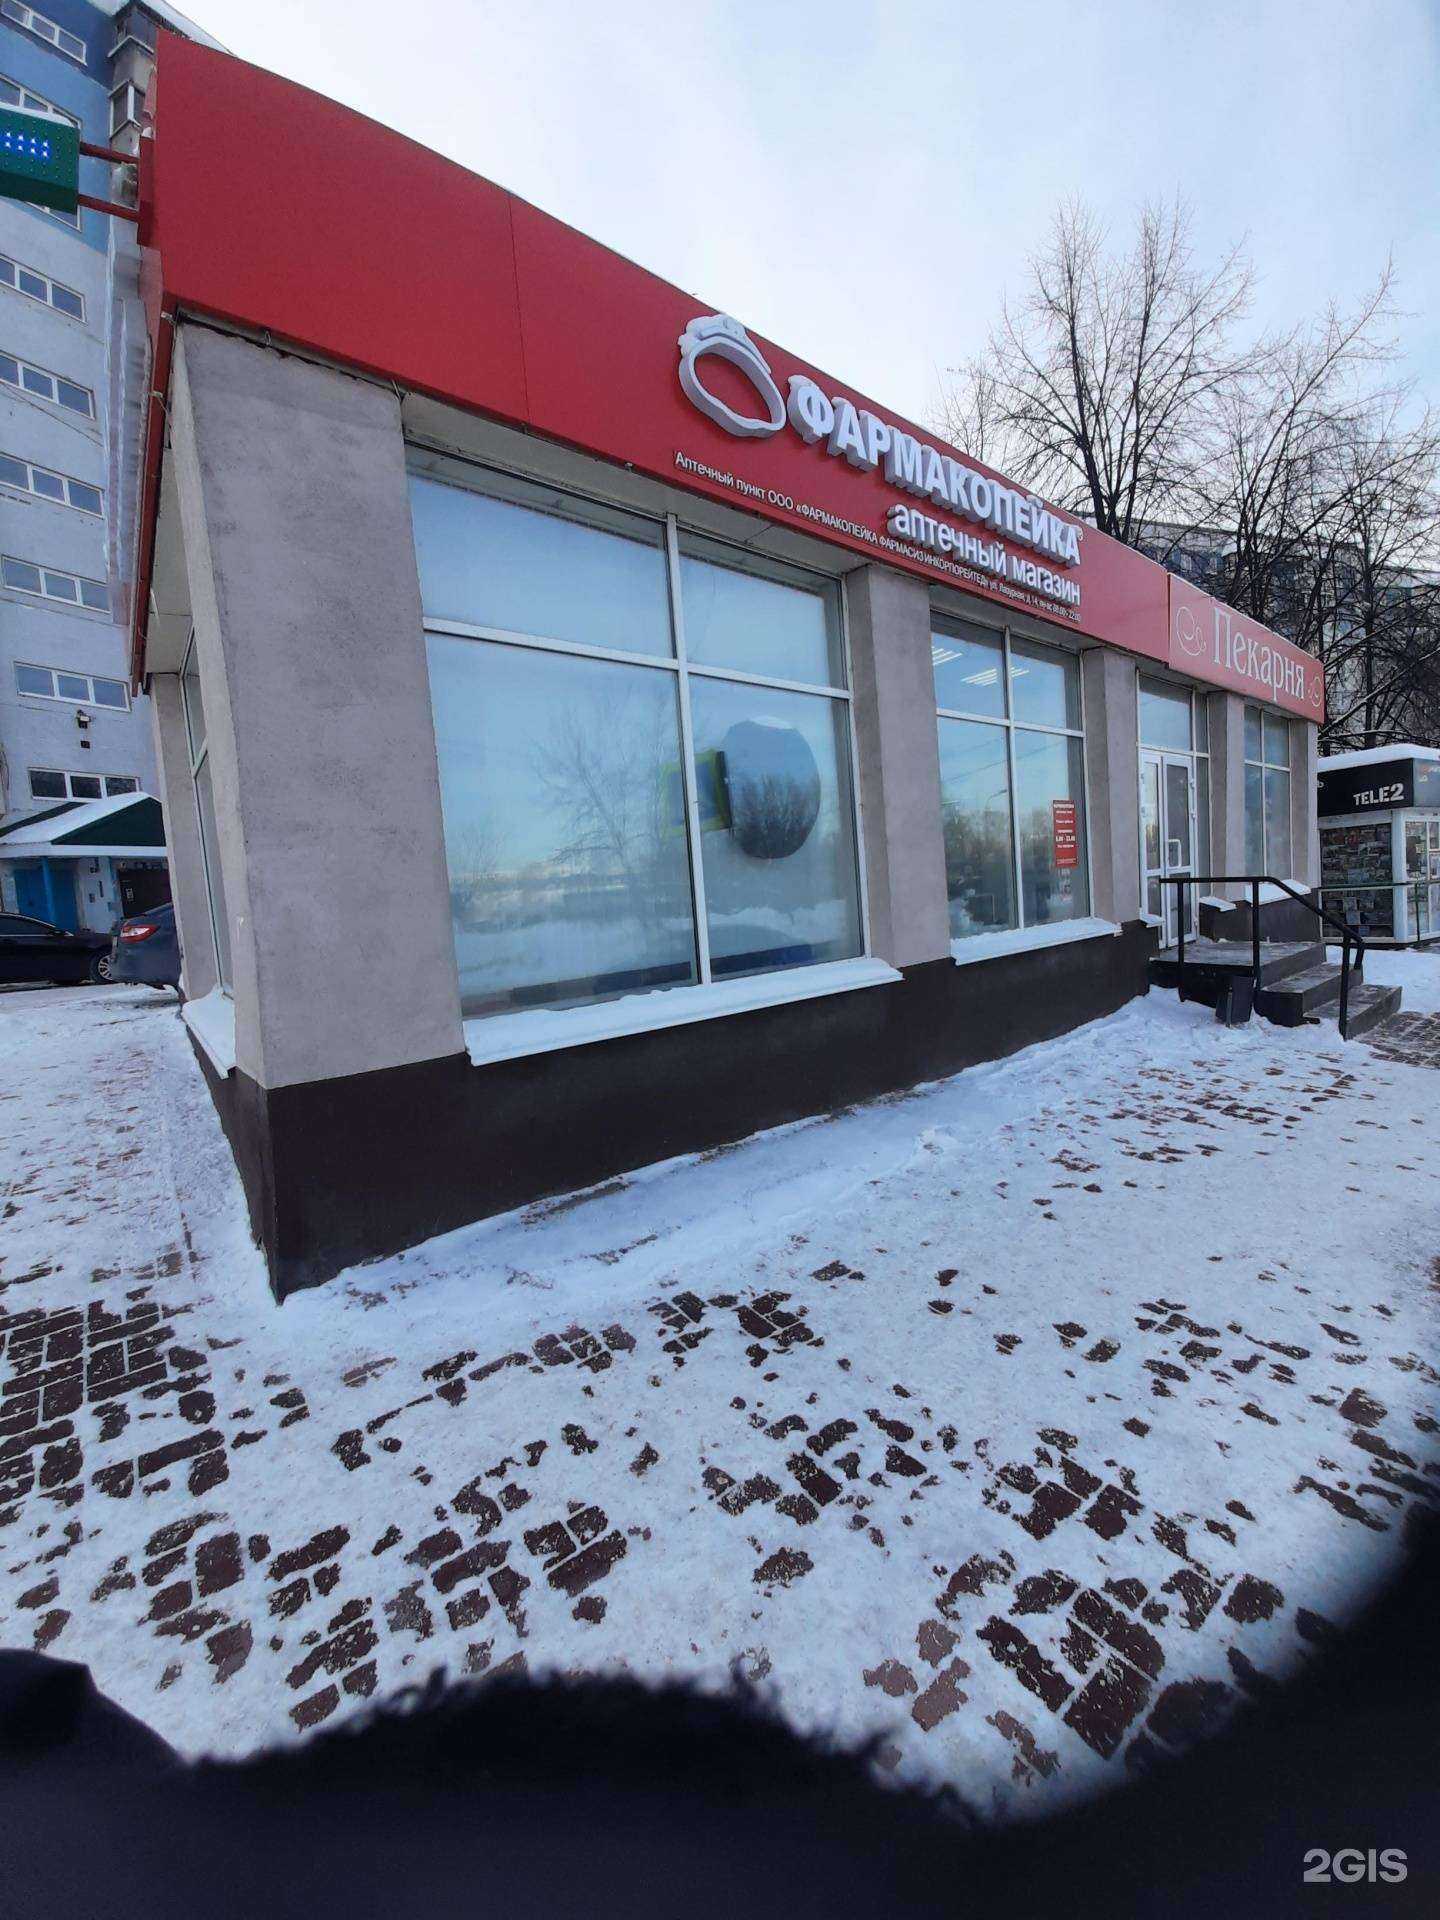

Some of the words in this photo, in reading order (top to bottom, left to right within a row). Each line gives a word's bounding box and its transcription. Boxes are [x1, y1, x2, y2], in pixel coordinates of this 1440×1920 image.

[675, 451, 733, 487] Аптечный
[736, 479, 765, 500] пункт
[767, 490, 794, 511] ООО
[796, 503, 878, 546] «ФАРМАКОПЕЙКА
[789, 375, 1082, 568] ФАРМАКОПЕЙКА
[888, 503, 1007, 577] аптечный
[1011, 556, 1081, 607] магазин
[1214, 607, 1304, 702] Пекарня
[1353, 782, 1404, 806] TELE2
